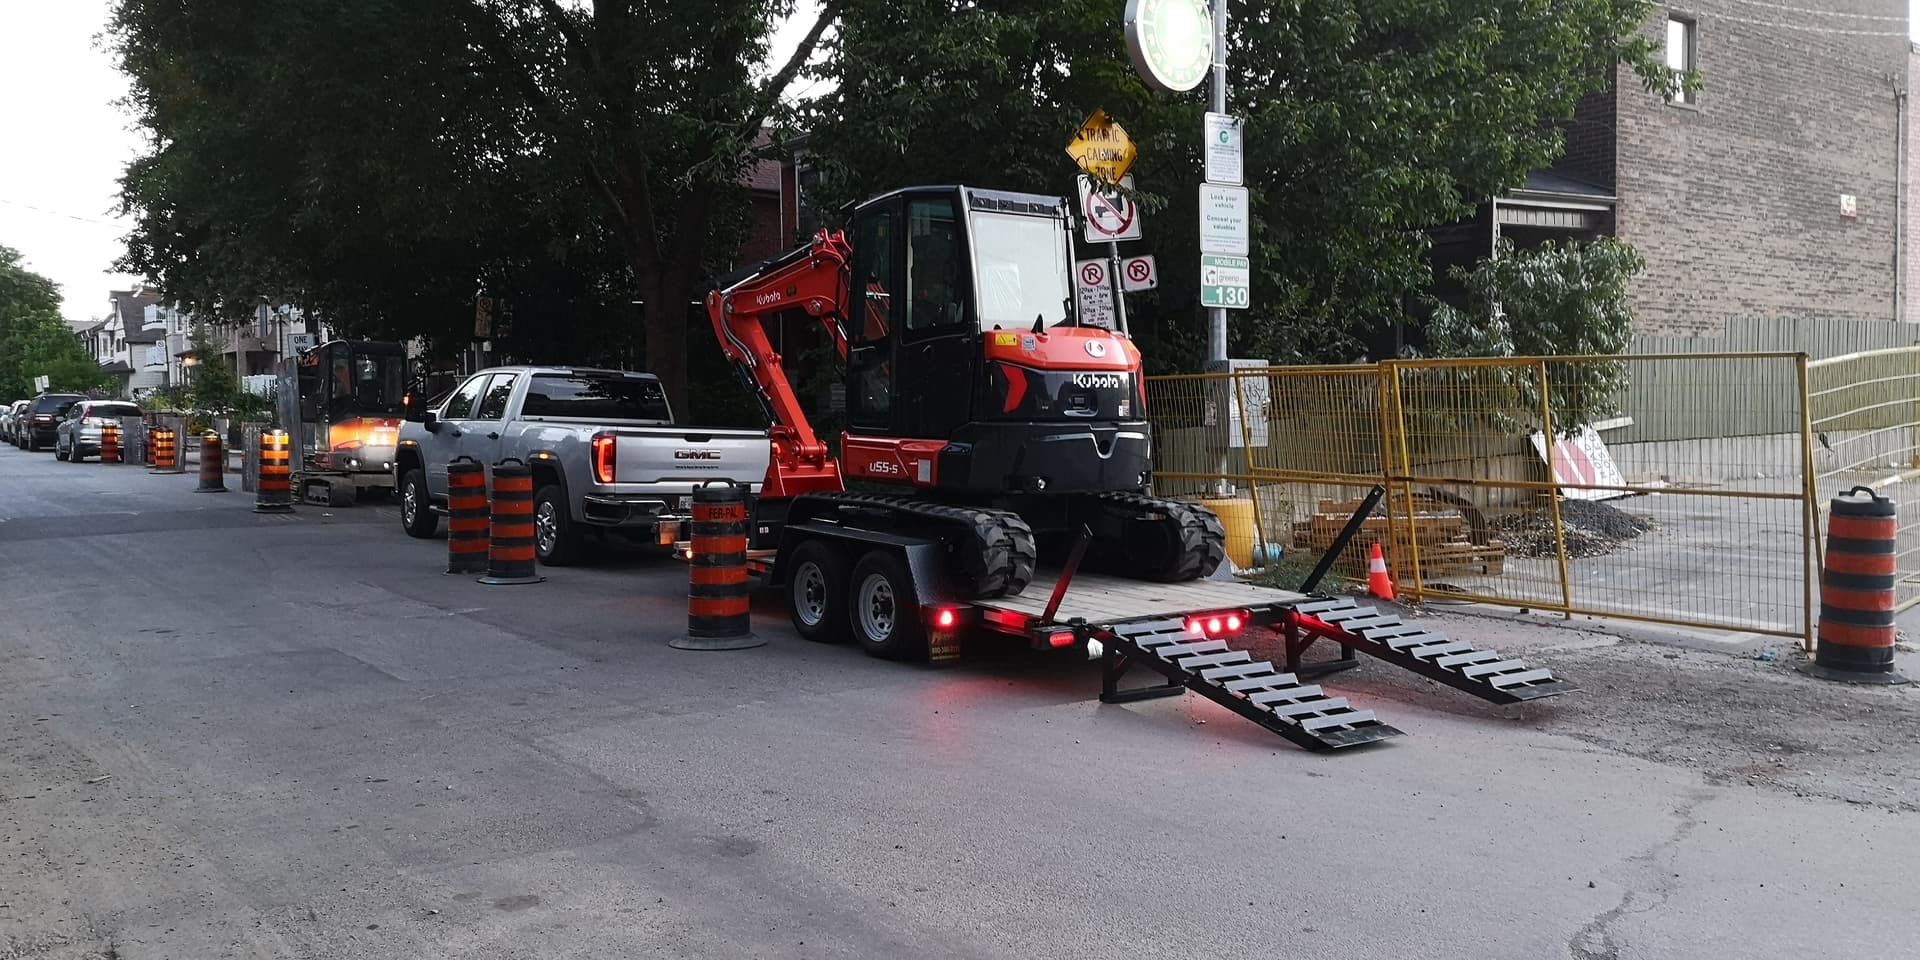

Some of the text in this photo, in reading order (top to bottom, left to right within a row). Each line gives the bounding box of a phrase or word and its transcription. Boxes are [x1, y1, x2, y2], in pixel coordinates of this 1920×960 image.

[1085, 128, 1119, 142] TRAFFIC
[1087, 148, 1123, 161] CALMING
[1096, 167, 1117, 181] ZONE
[1214, 257, 1247, 268] MOBILE PAY
[756, 290, 780, 305] Kubota
[1215, 287, 1247, 305] 130
[294, 335, 308, 344] ONE
[1073, 373, 1119, 389] Kubota
[675, 449, 721, 460] GMC
[708, 506, 738, 519] FER-PAL
